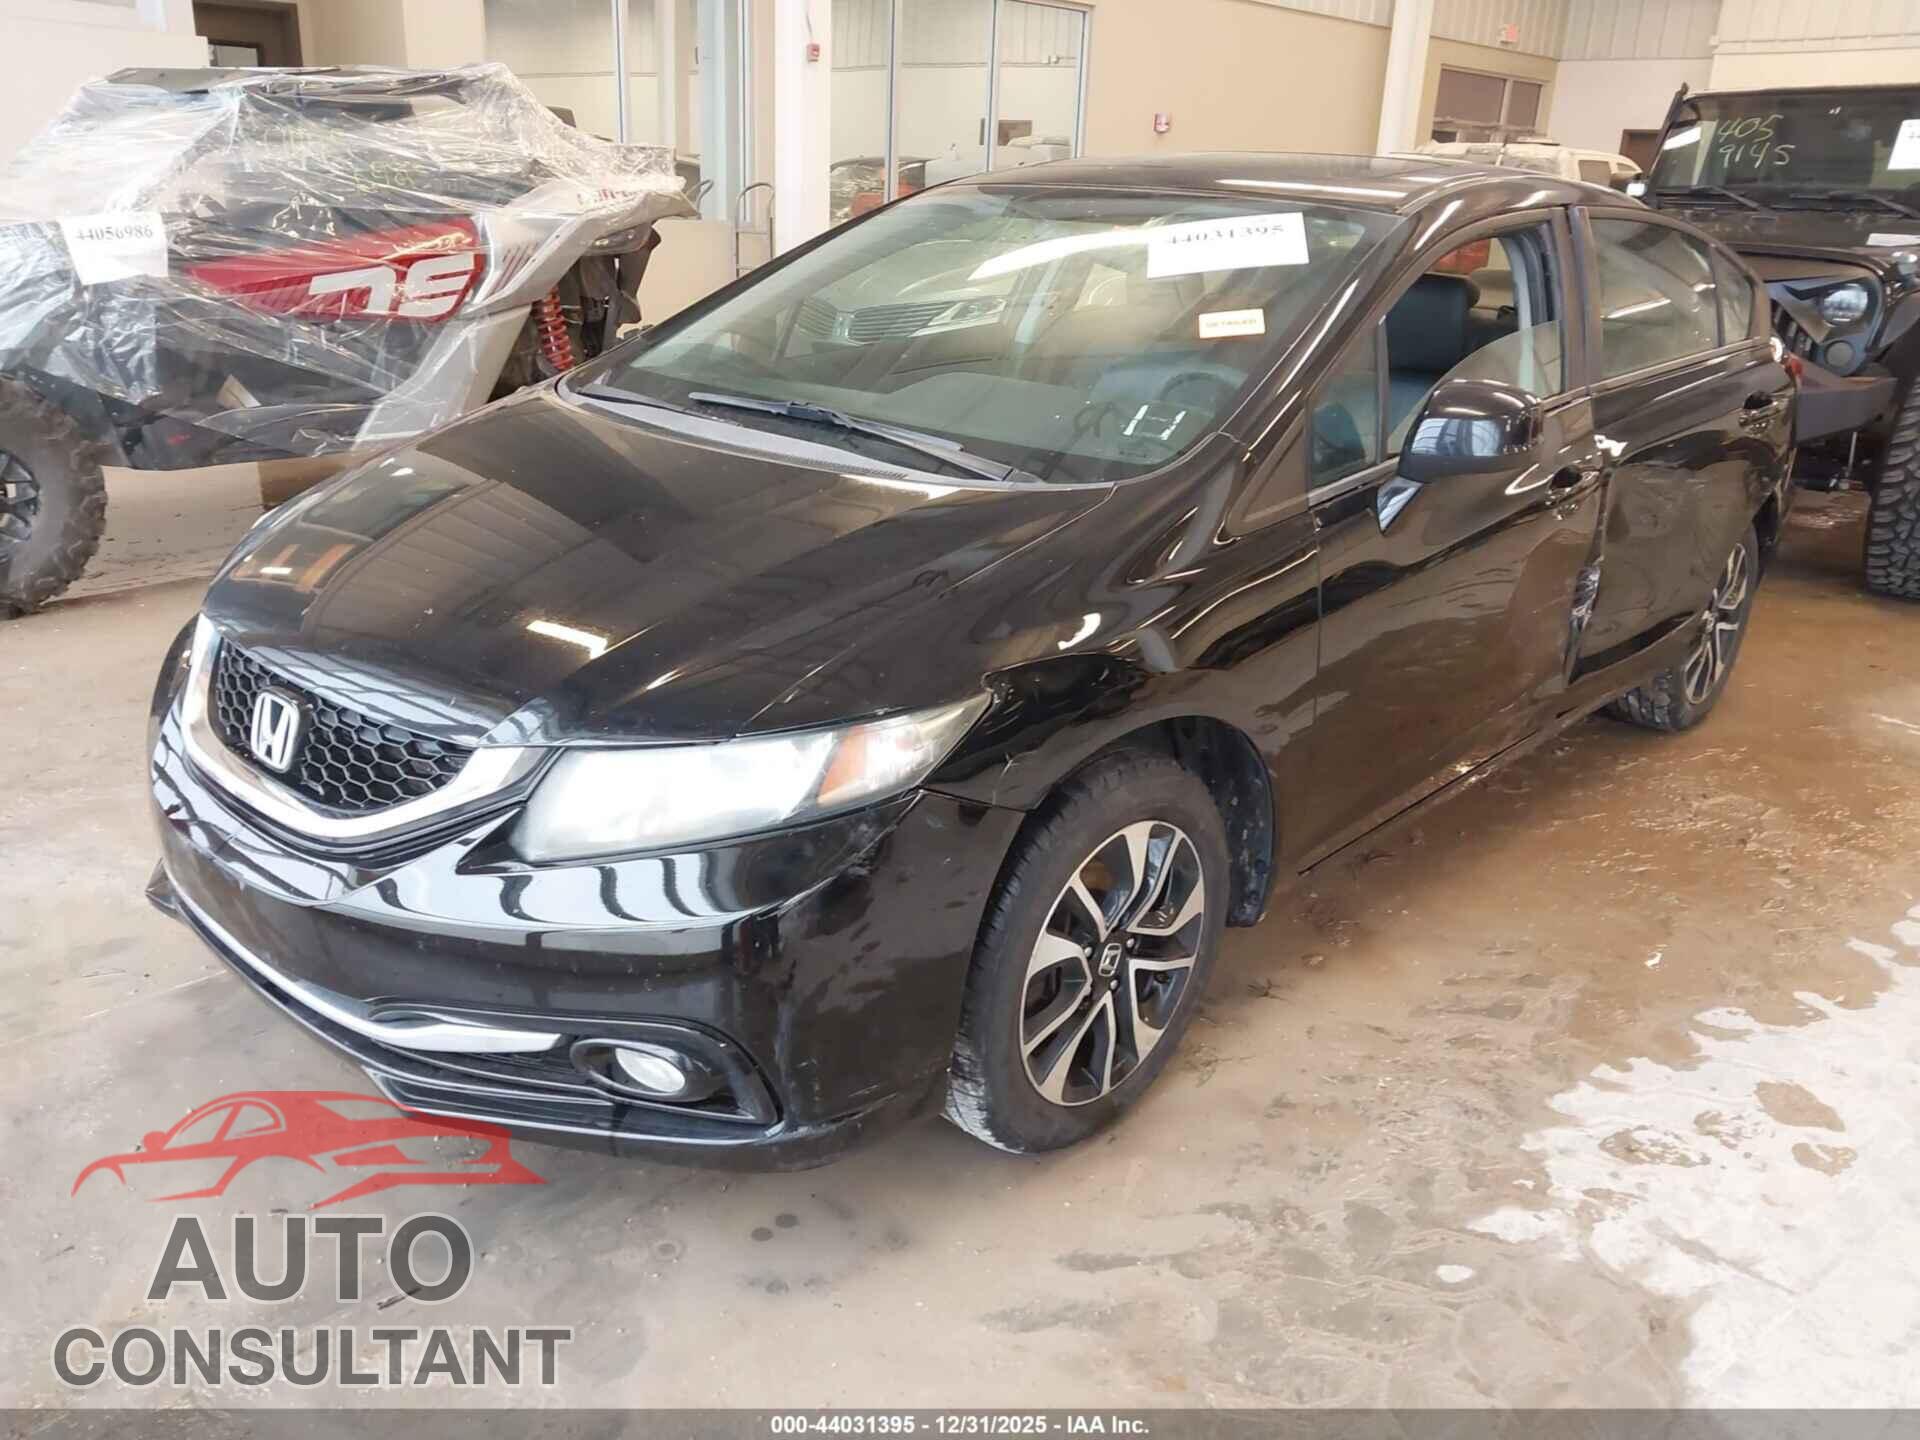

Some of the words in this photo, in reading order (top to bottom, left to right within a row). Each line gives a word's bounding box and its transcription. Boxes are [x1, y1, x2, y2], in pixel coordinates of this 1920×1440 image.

[1719, 115, 1784, 142] 405
[1719, 143, 1796, 168] 9145
[75, 225, 154, 241] 44056986
[1167, 223, 1286, 244] 44031395
